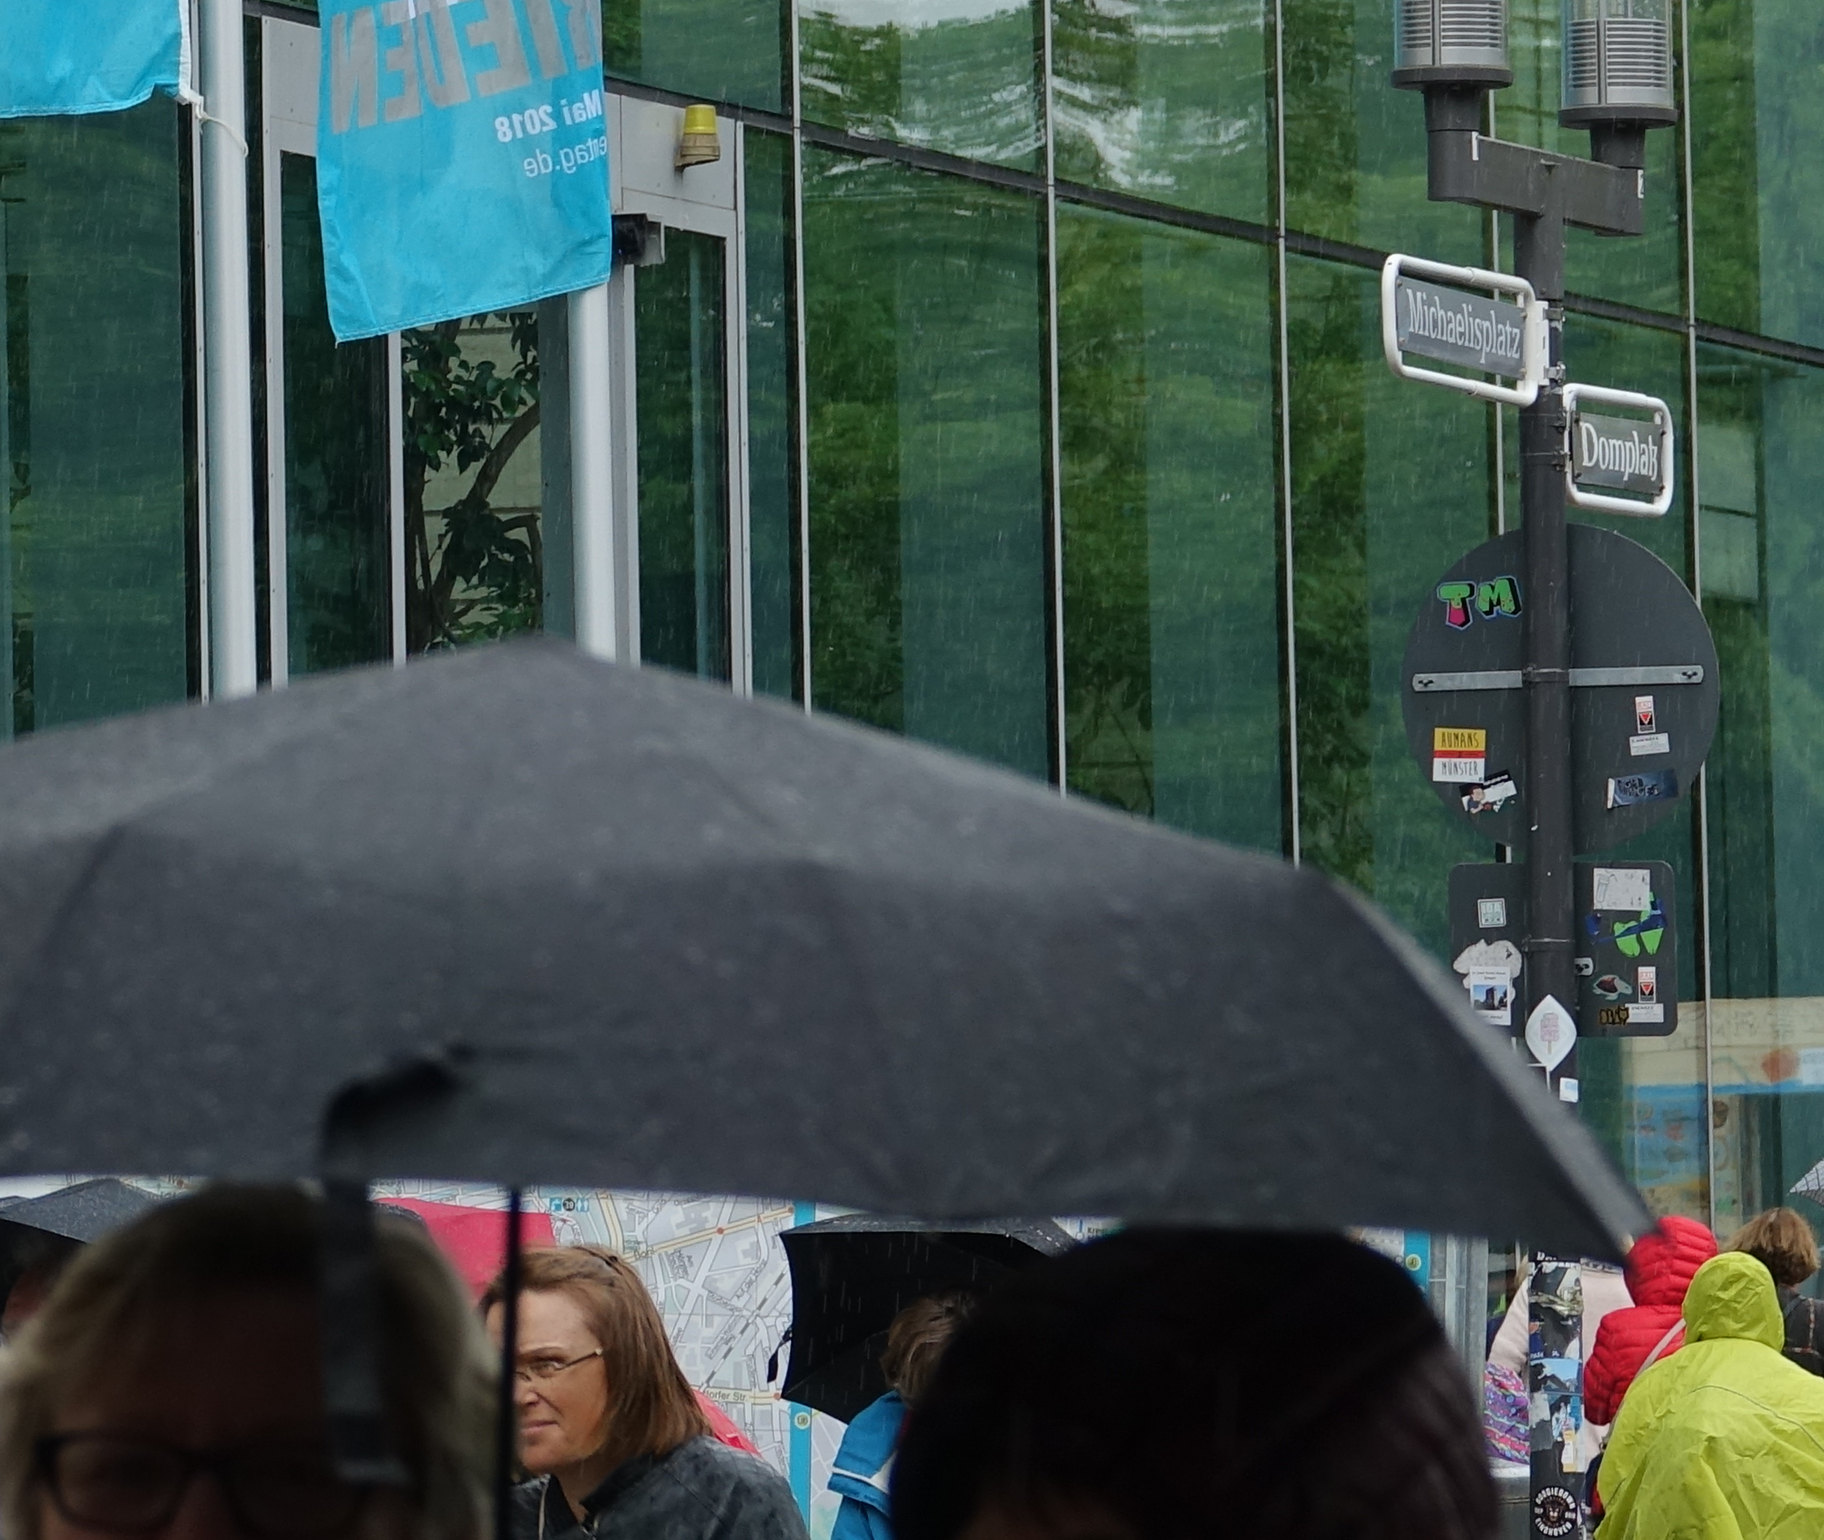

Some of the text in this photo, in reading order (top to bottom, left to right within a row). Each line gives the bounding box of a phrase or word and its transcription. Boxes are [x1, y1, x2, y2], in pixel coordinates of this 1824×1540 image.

[1406, 288, 1521, 364] Michaelisplatz
[1579, 421, 1658, 481] Domplatz
[1437, 576, 1522, 630] TM
[1441, 759, 1479, 776] MÜNSTER
